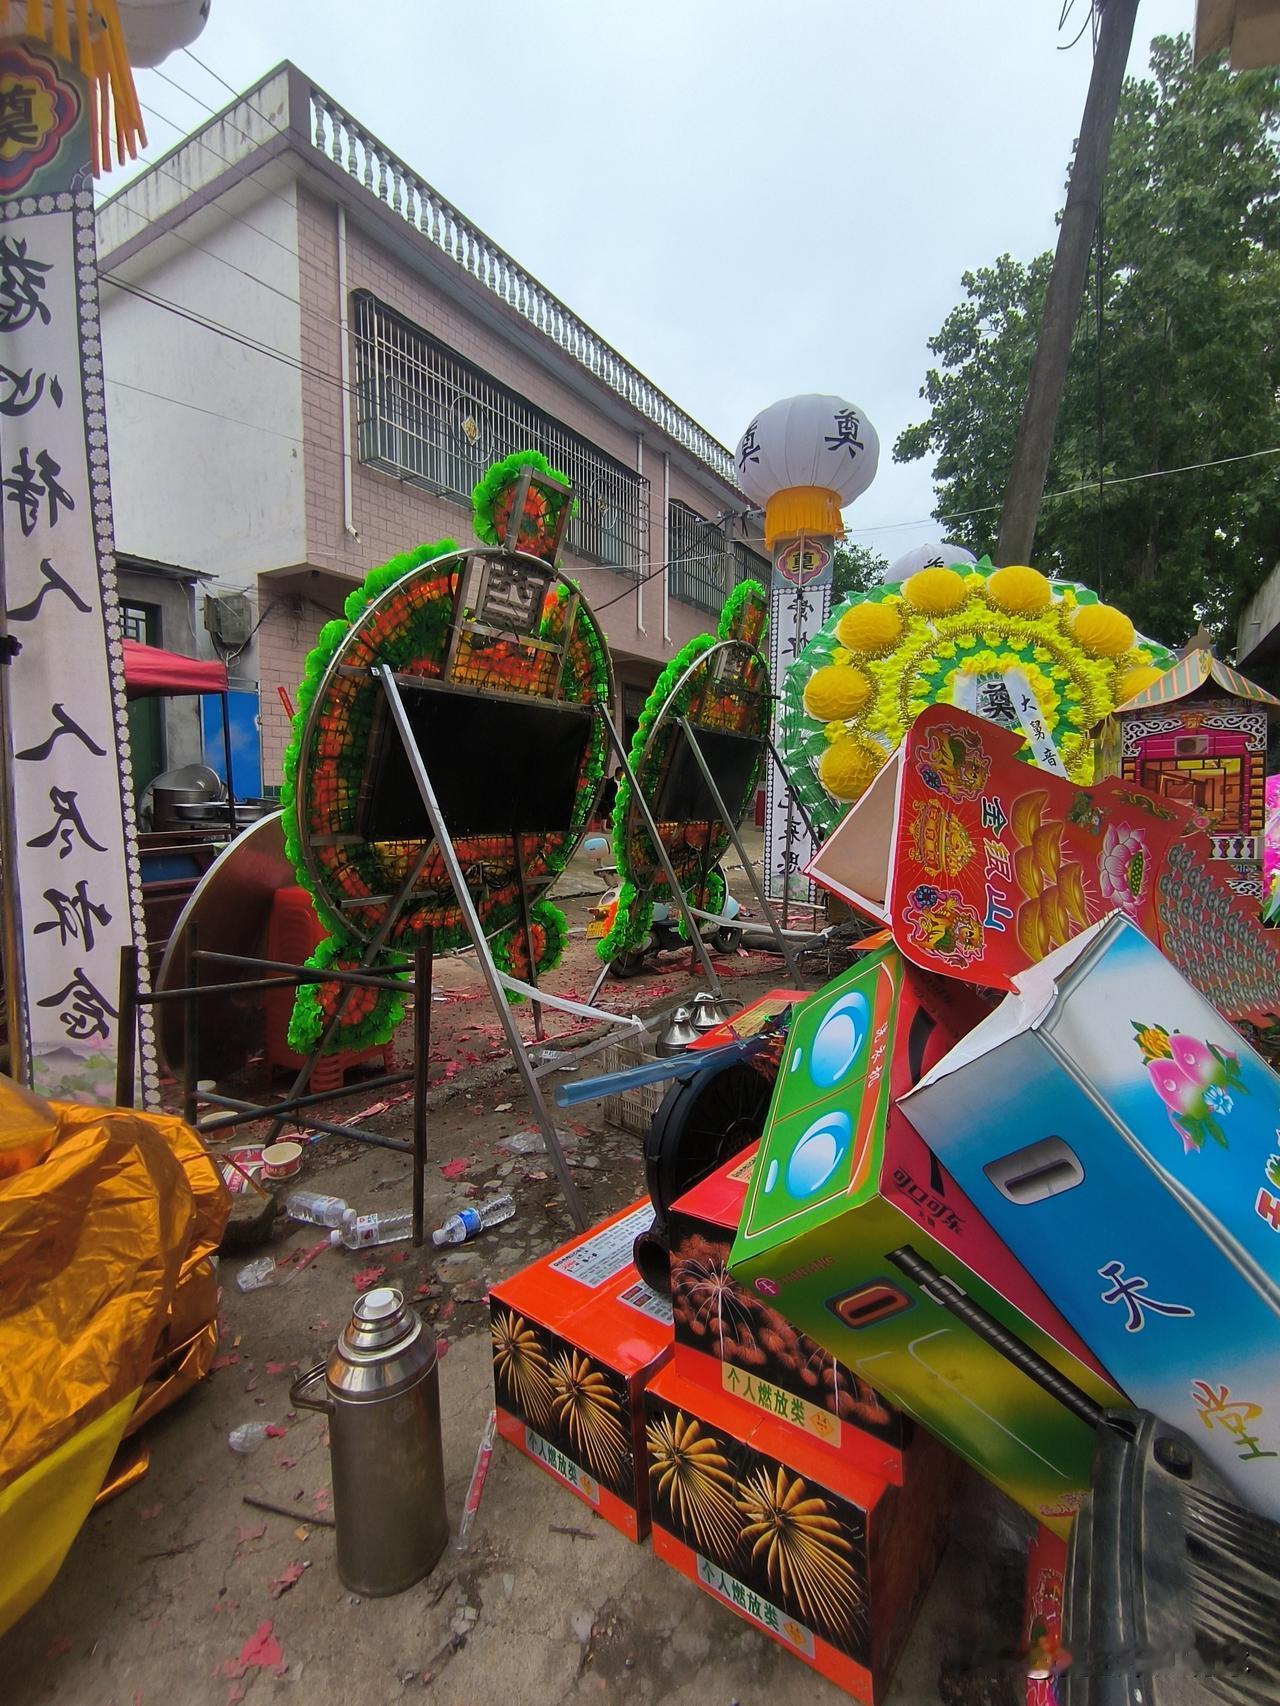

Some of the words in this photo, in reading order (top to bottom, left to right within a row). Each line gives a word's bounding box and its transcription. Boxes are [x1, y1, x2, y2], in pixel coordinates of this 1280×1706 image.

[824, 409, 864, 459] 奠
[982, 683, 1016, 720] 奠
[981, 796, 1014, 932] 金银山
[893, 1166, 966, 1235] 可口可乐
[728, 1367, 805, 1427] 个人燃放类
[528, 1432, 578, 1486] 个人燃放类
[702, 1560, 779, 1631] 个人燃放类
